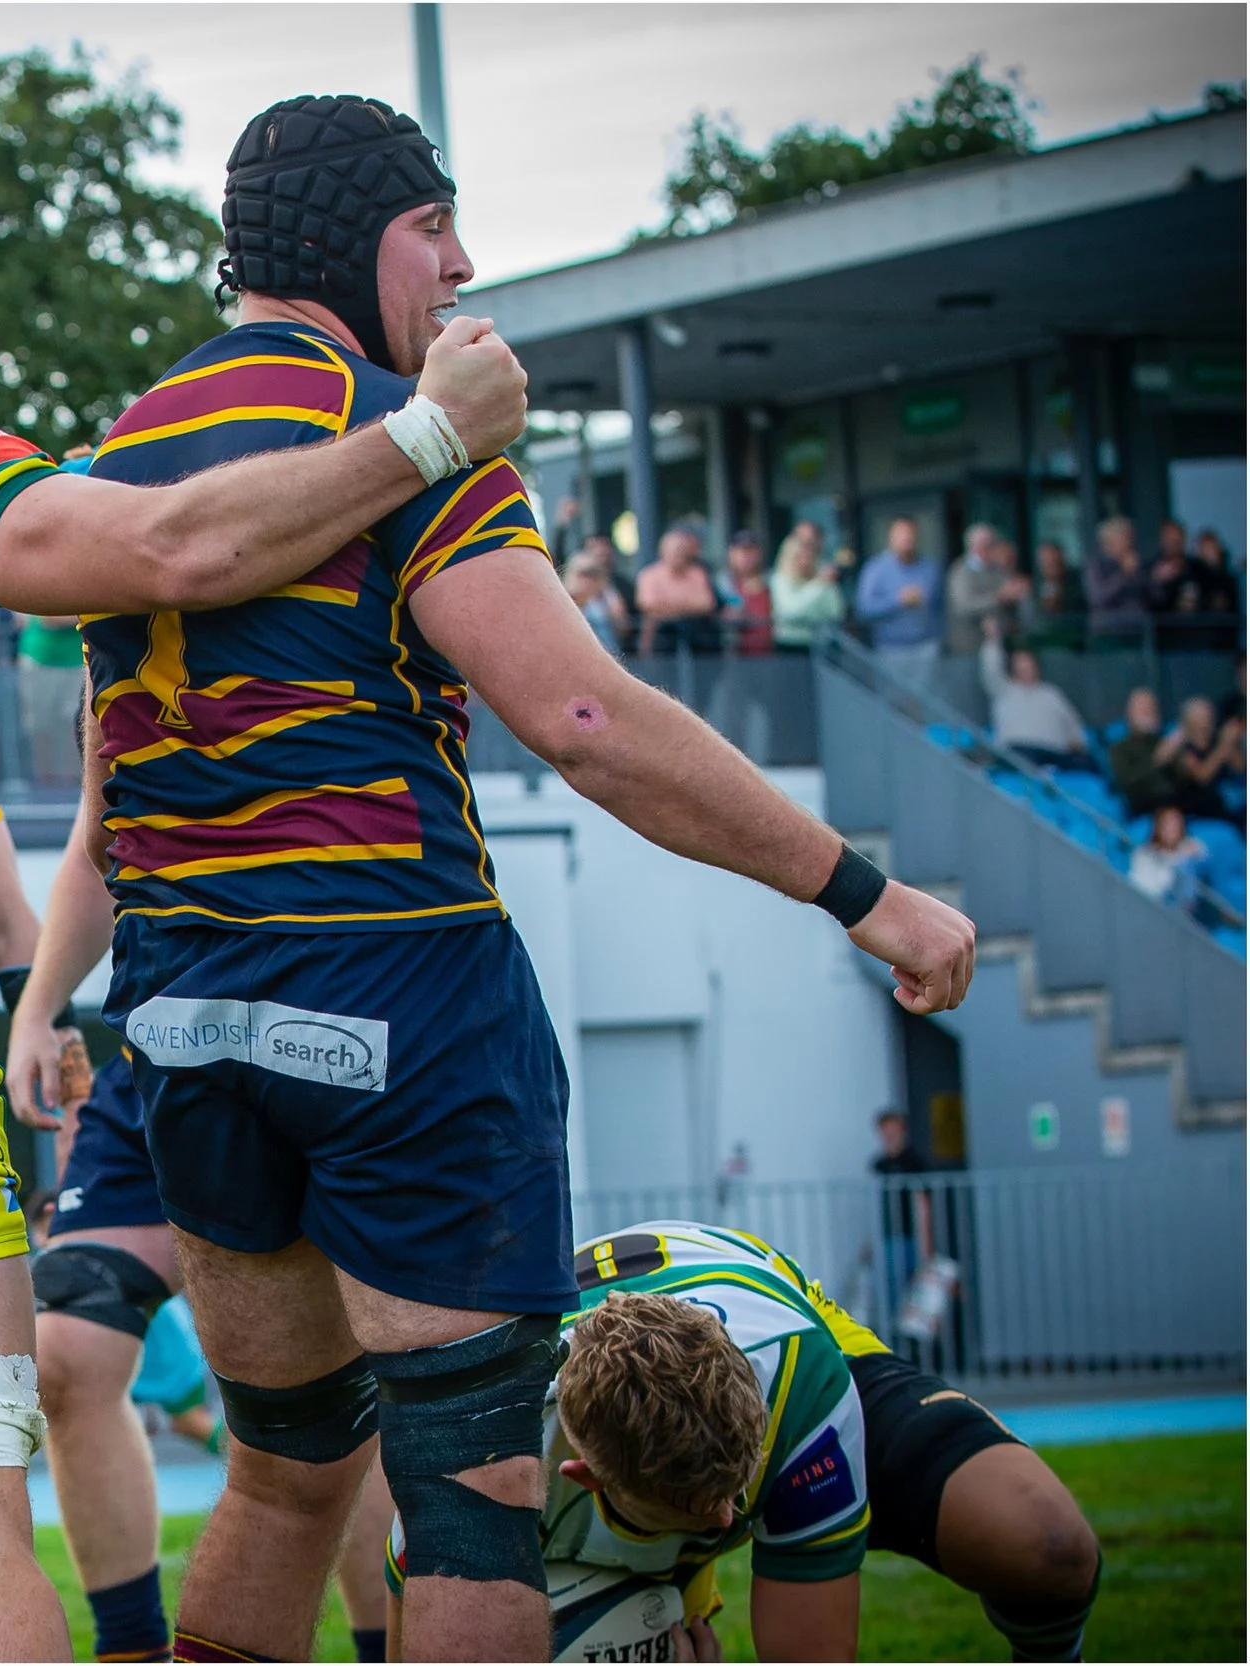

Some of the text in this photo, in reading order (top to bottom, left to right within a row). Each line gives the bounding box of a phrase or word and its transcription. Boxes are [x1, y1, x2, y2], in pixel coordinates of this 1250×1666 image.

[133, 1022, 260, 1050] CAVENDISH
[272, 1036, 356, 1069] search
[791, 1456, 836, 1489] KING
